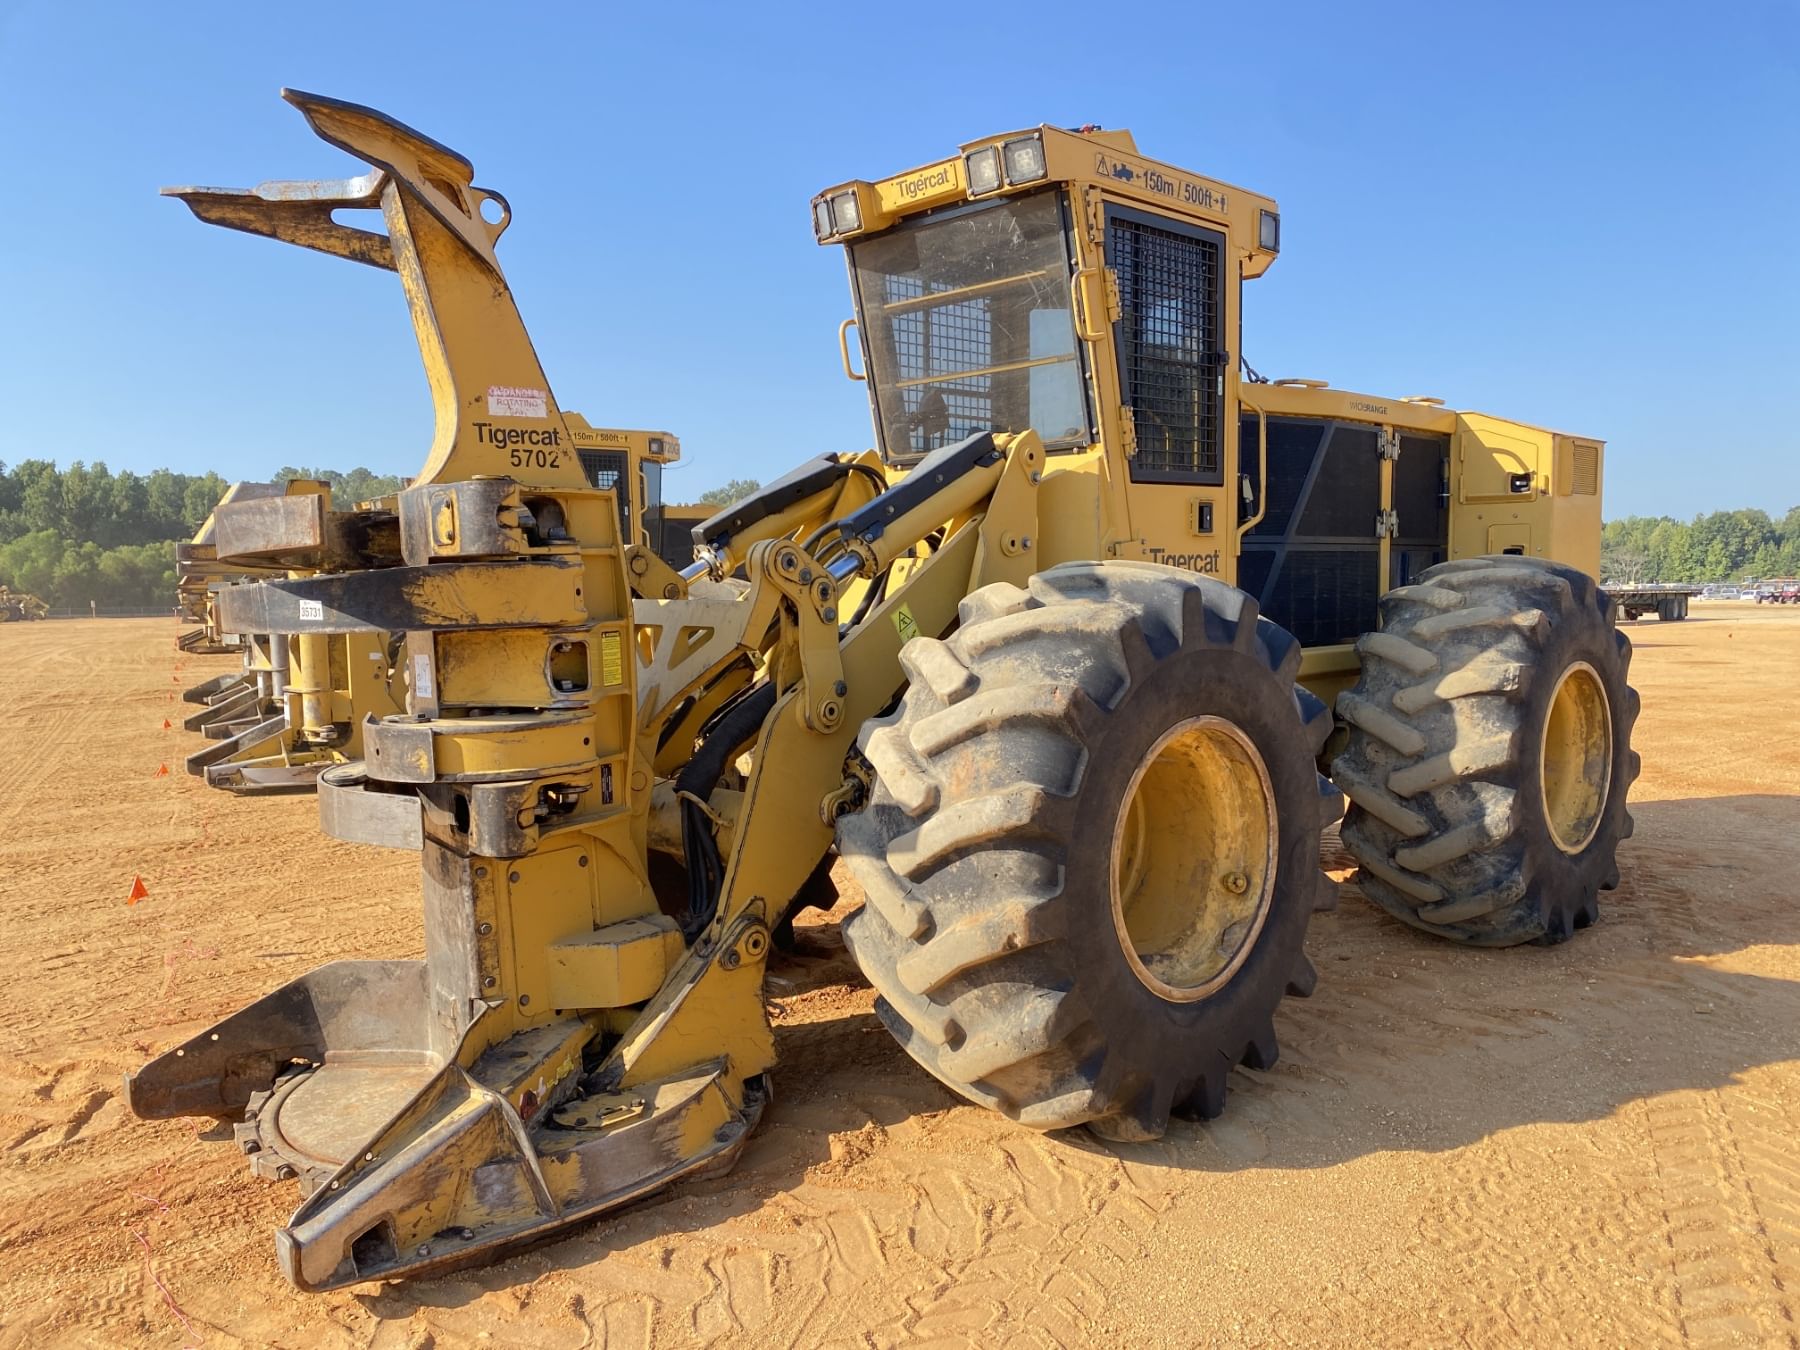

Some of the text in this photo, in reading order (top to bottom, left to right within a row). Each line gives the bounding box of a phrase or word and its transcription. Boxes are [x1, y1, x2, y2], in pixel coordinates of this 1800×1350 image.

[896, 167, 950, 198] Tigercat
[1143, 170, 1174, 197] 150m
[1184, 183, 1213, 208] 500ft
[472, 422, 561, 449] Tigercat
[510, 448, 560, 469] 5702
[301, 606, 321, 618] 35731
